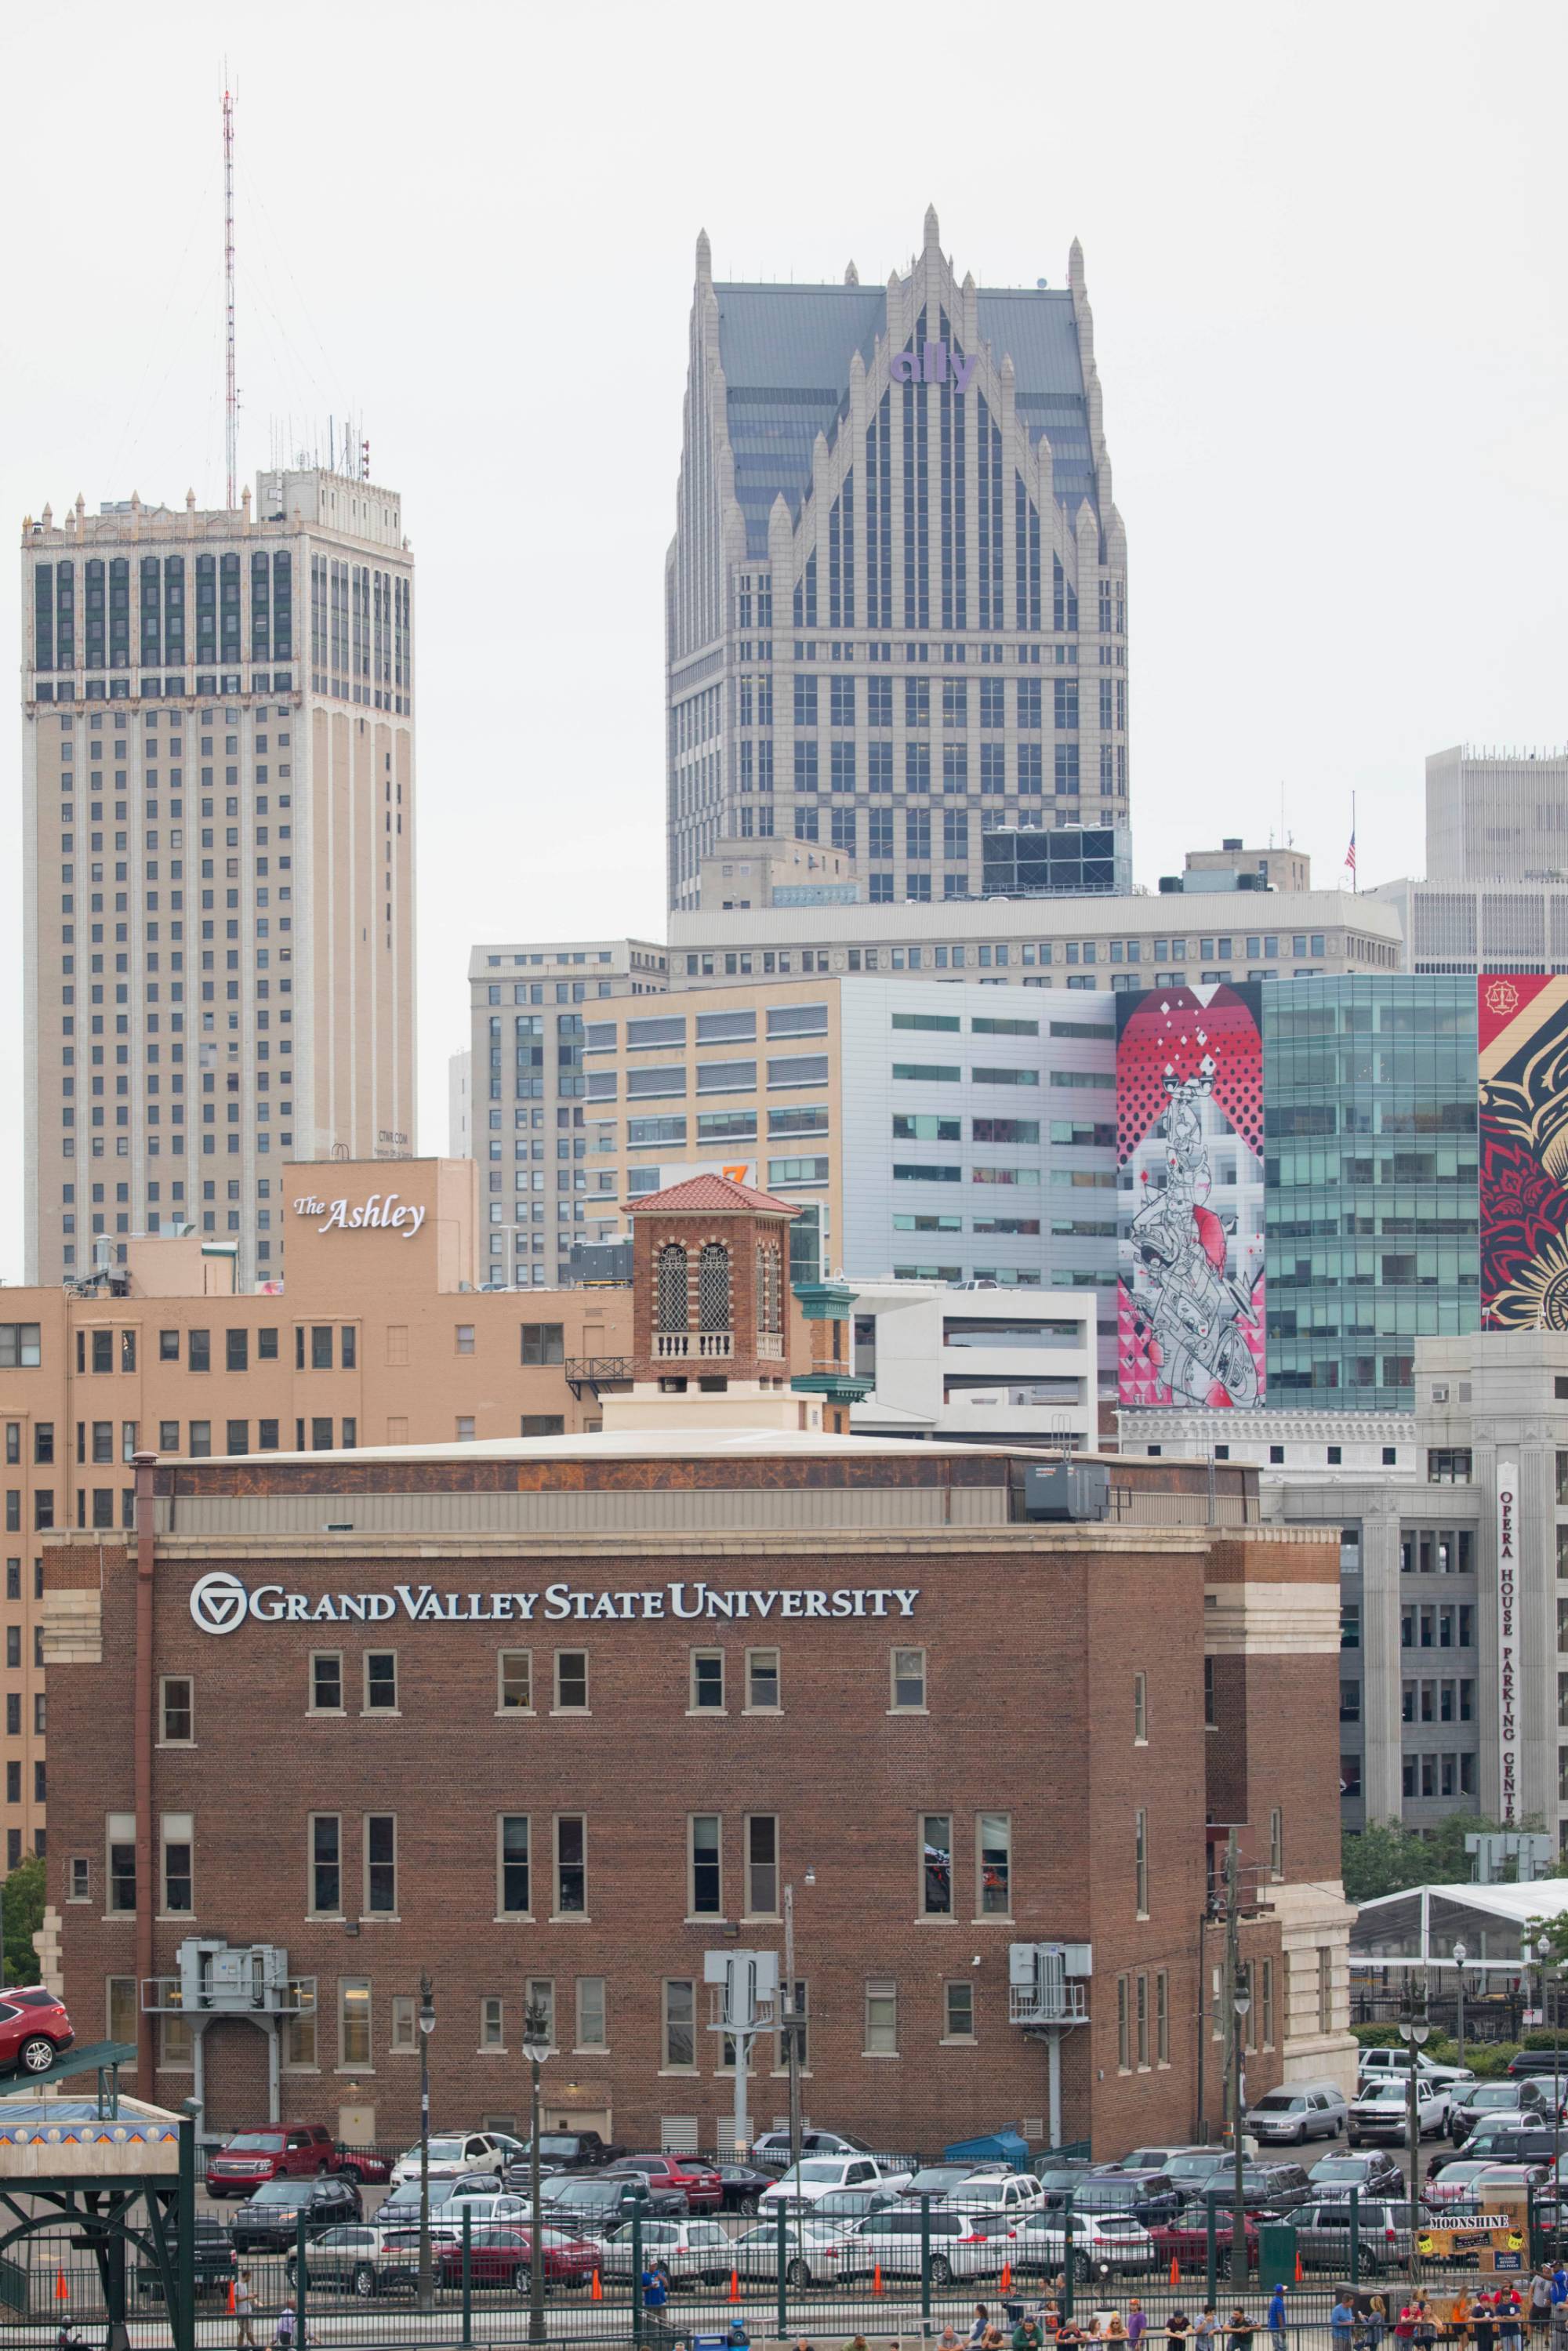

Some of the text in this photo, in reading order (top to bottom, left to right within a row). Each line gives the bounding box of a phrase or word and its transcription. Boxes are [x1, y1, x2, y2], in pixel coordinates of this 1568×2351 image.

[891, 342, 978, 394] ally
[293, 1194, 426, 1238] The Ashley
[1501, 1491, 1514, 1558] OPERA
[249, 1582, 920, 1621] GRAND VALLEY STATE UNIVERSITY
[1501, 1569, 1514, 1636] HOUSE
[1502, 1647, 1515, 1741] PARKING
[1431, 2215, 1508, 2229] MOONSHINE
